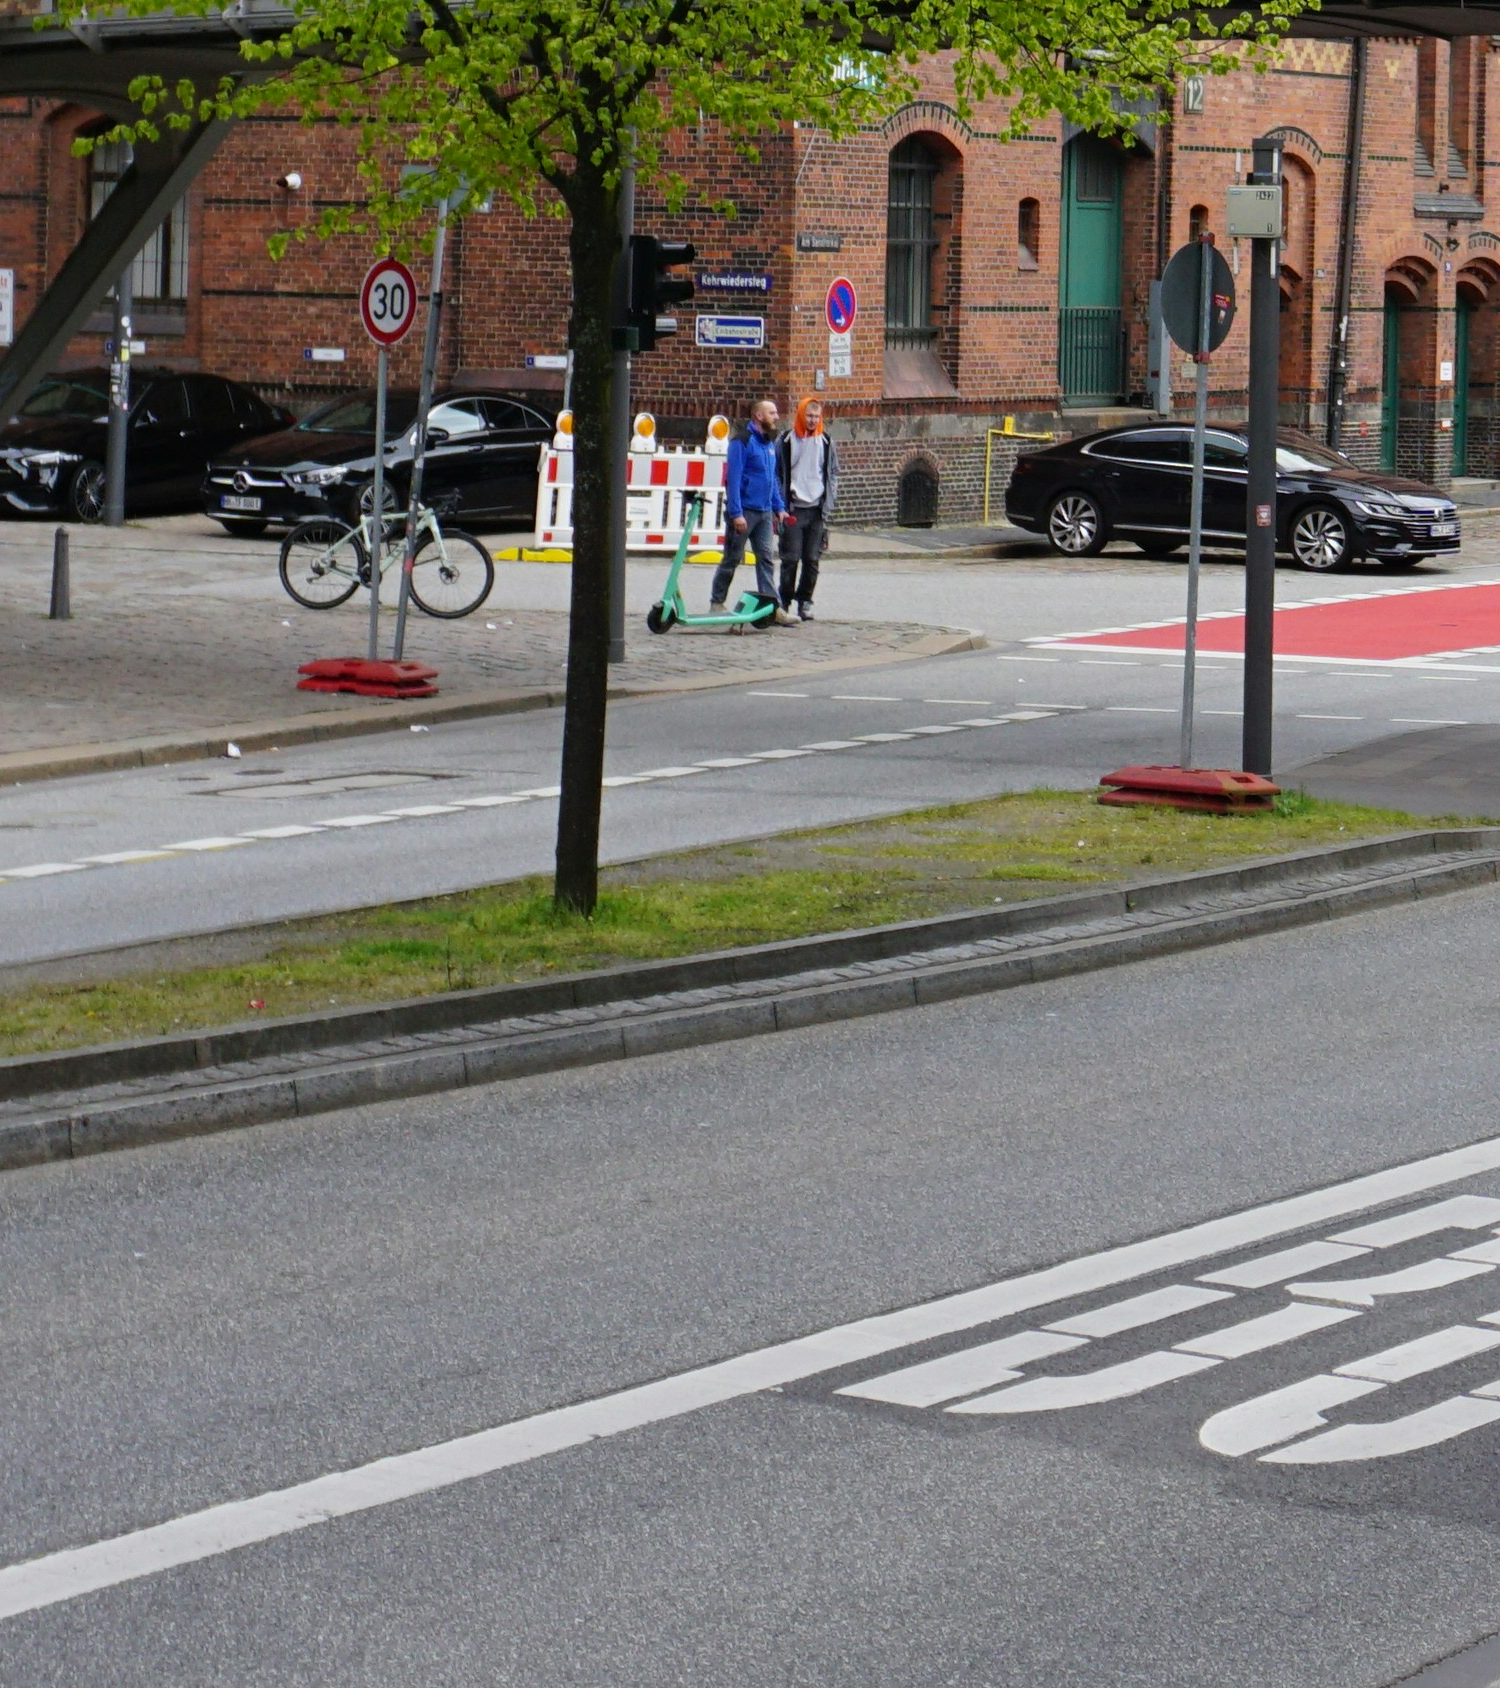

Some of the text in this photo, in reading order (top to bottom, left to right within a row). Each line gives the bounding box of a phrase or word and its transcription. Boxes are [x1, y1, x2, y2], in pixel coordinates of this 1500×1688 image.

[1187, 79, 1204, 111] 12
[702, 273, 766, 291] Kehrwiedersteg
[373, 283, 404, 320] 30
